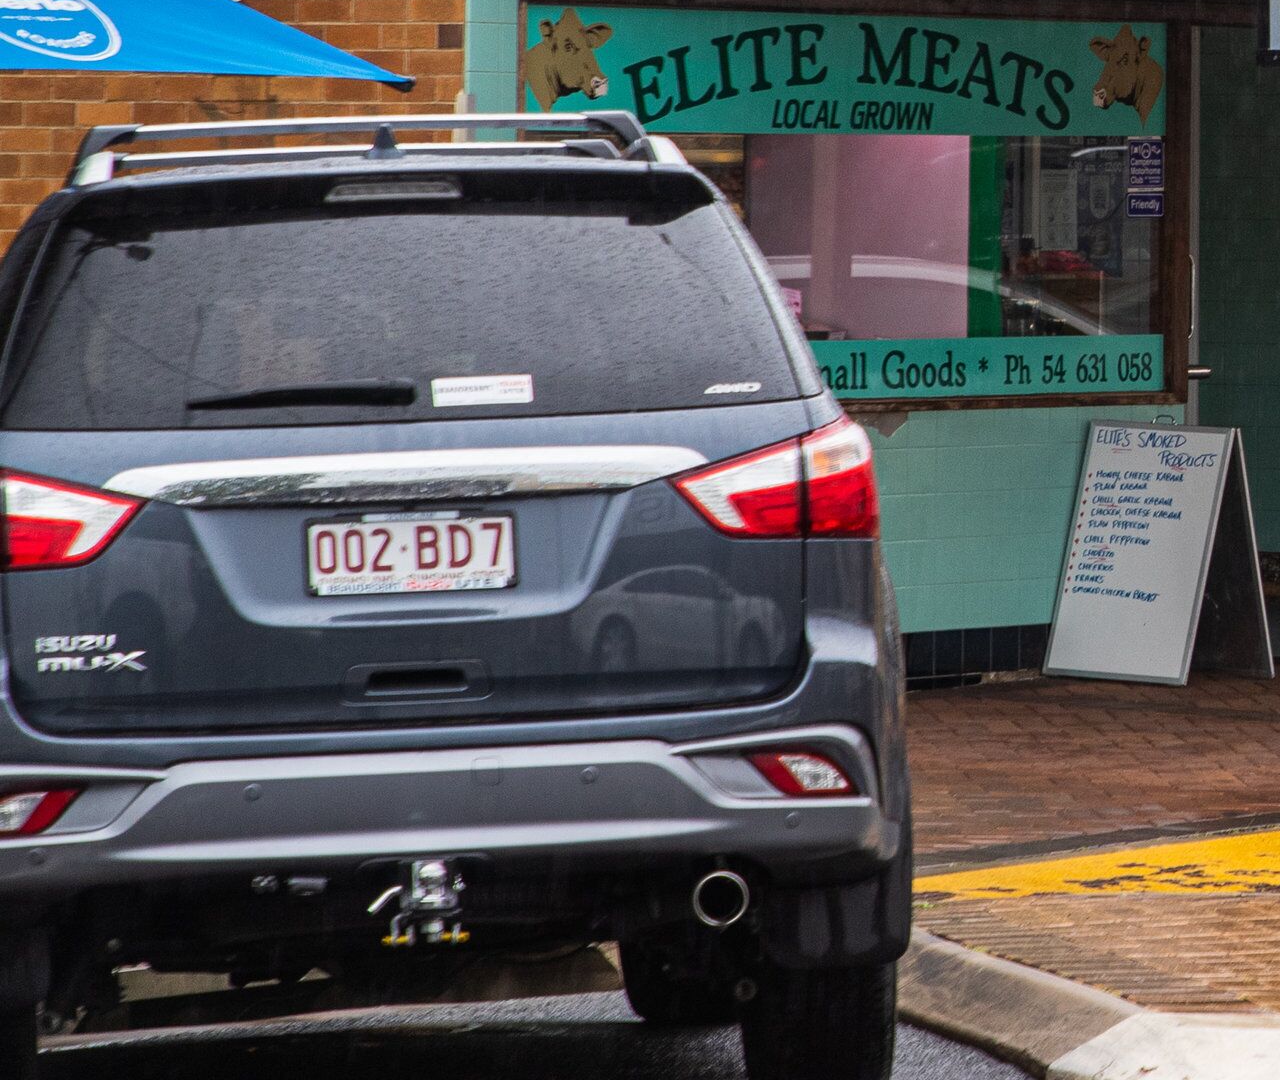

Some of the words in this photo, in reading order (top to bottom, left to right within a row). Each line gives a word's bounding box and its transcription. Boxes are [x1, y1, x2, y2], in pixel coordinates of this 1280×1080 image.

[623, 23, 828, 124] ELITE
[857, 22, 1074, 131] MEATS
[772, 99, 840, 129] LOCAL
[849, 100, 934, 130] GROWN
[1130, 199, 1160, 211] Friendly
[882, 350, 966, 390] Goods
[1004, 354, 1031, 385] Ph
[1042, 355, 1066, 384] 54
[1076, 353, 1107, 383] 631
[1118, 352, 1152, 382] 058
[1096, 429, 1132, 447] ELITE'S
[1138, 431, 1187, 448] SMOKED
[1158, 450, 1217, 467] PRODUCTS
[1124, 471, 1152, 481] CHEESE
[35, 634, 116, 653] ISUZU
